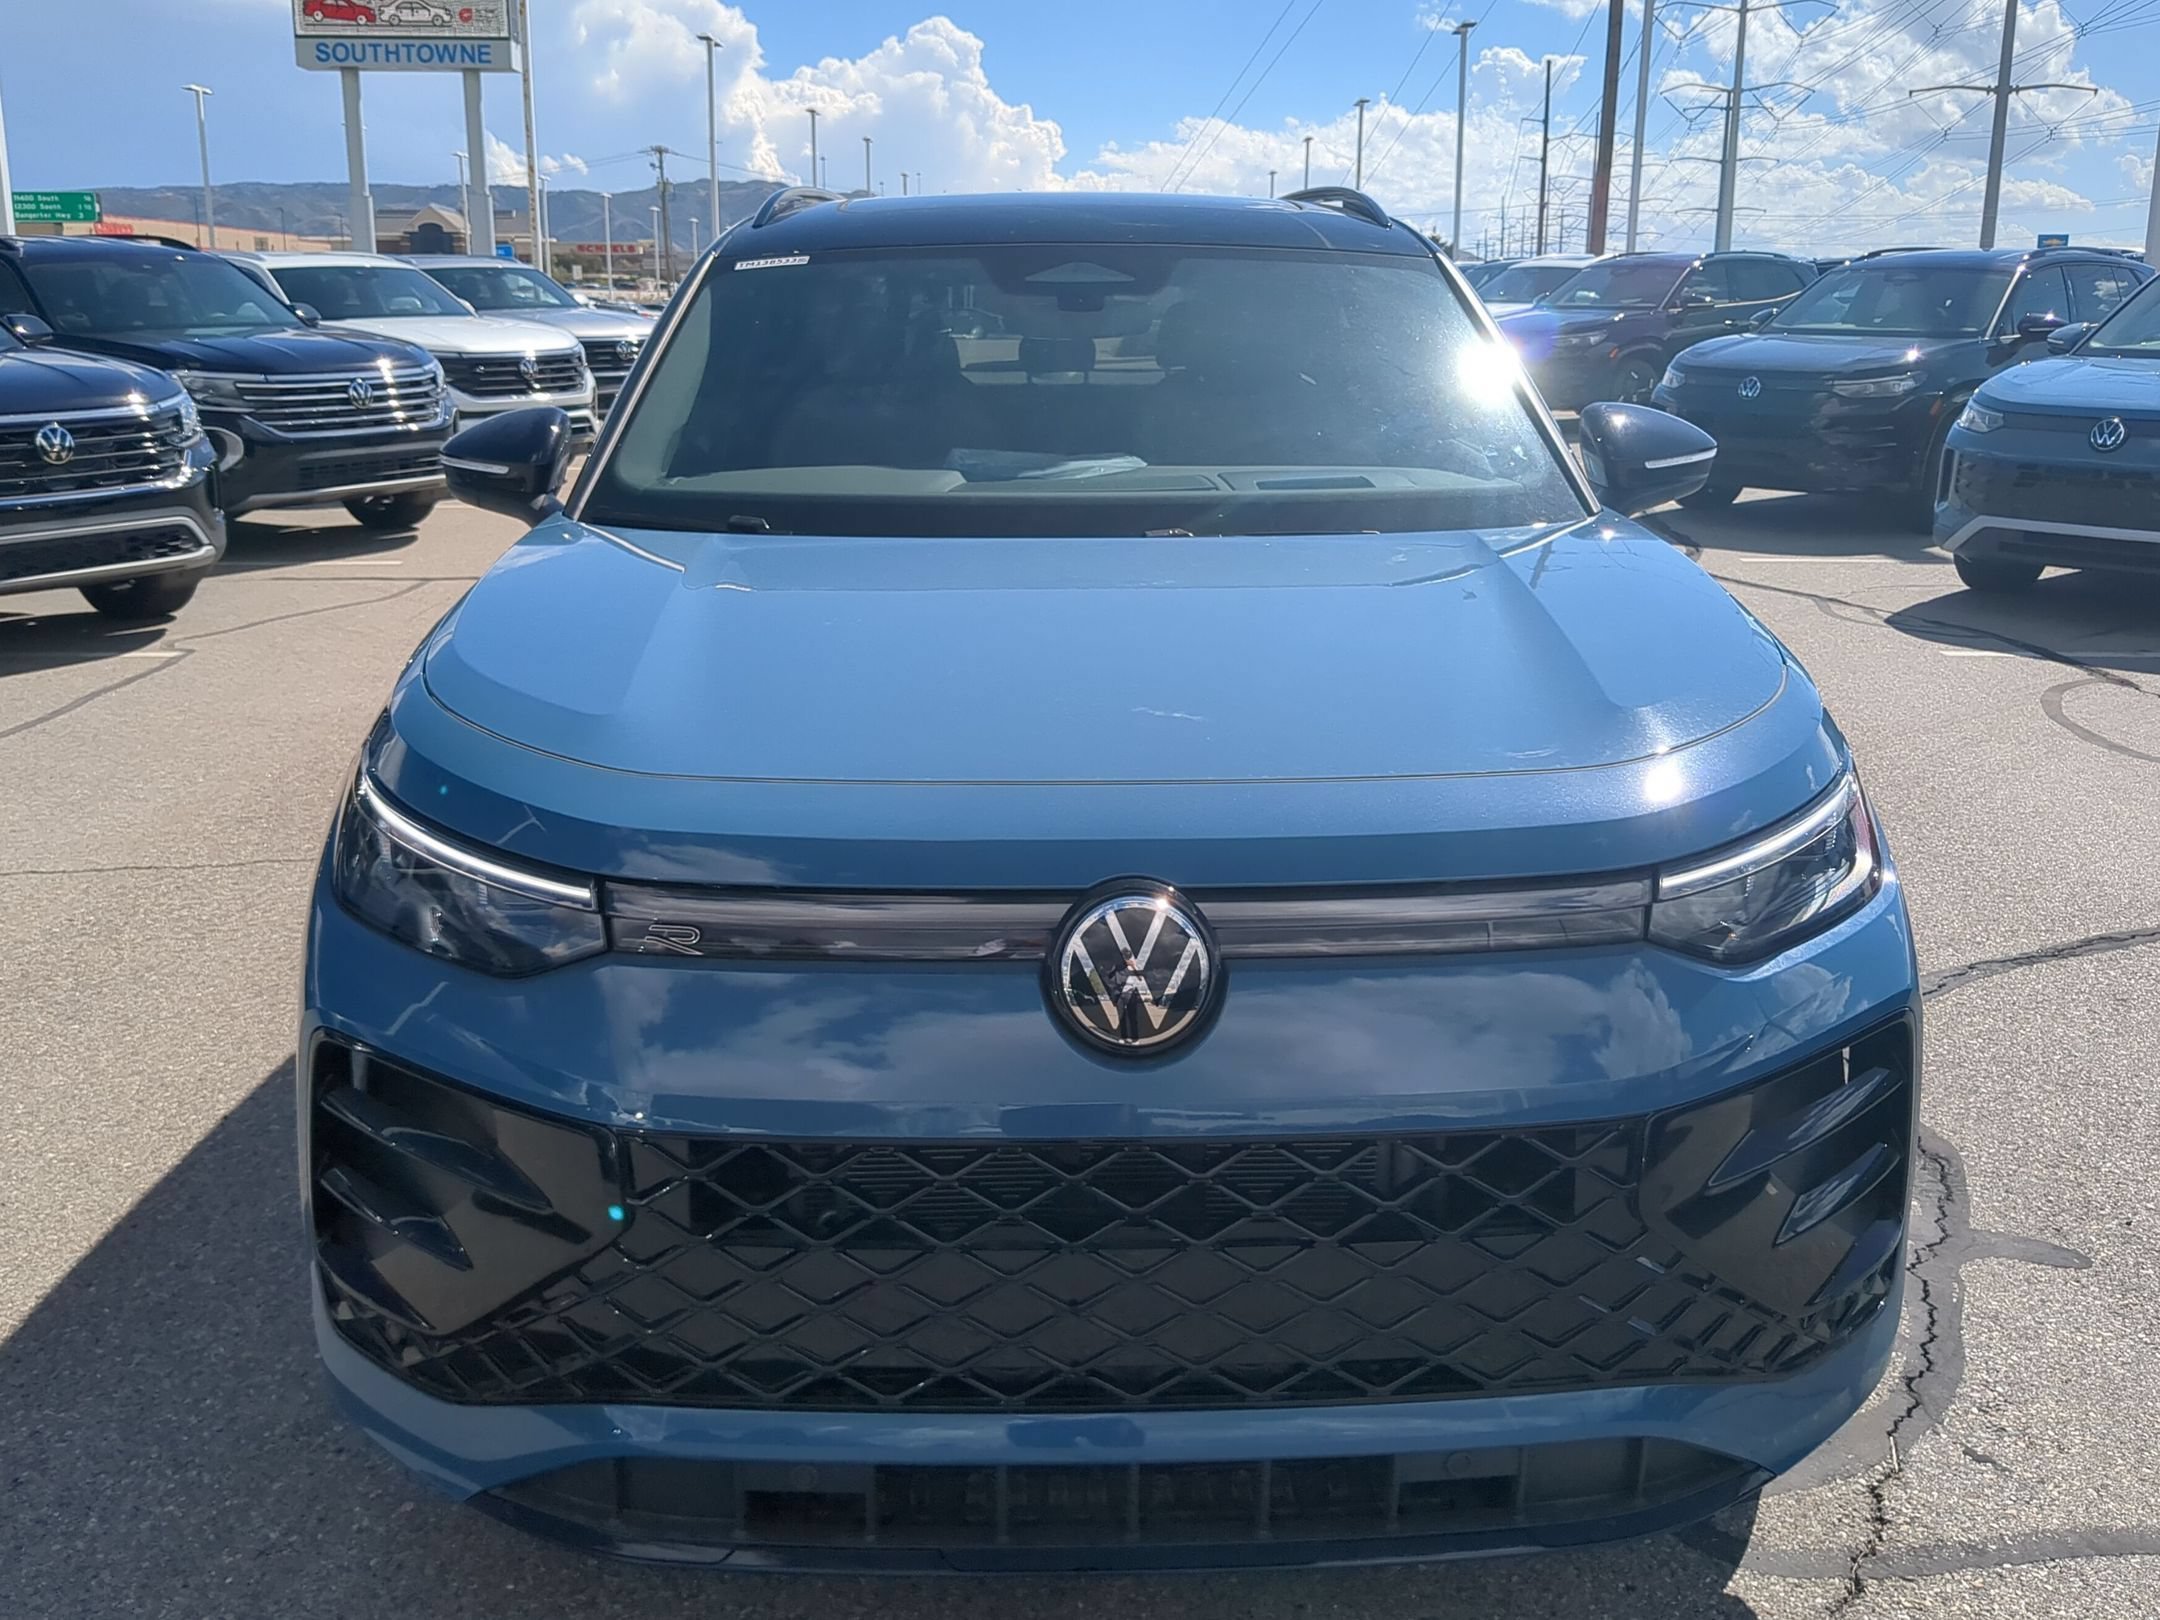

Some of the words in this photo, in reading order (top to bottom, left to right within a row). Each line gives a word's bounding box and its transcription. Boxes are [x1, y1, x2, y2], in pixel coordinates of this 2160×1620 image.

[315, 42, 492, 64] SOUTHTOWNE
[38, 425, 74, 464] VW
[2091, 419, 2124, 450] VW
[1064, 899, 1207, 1040] VW
